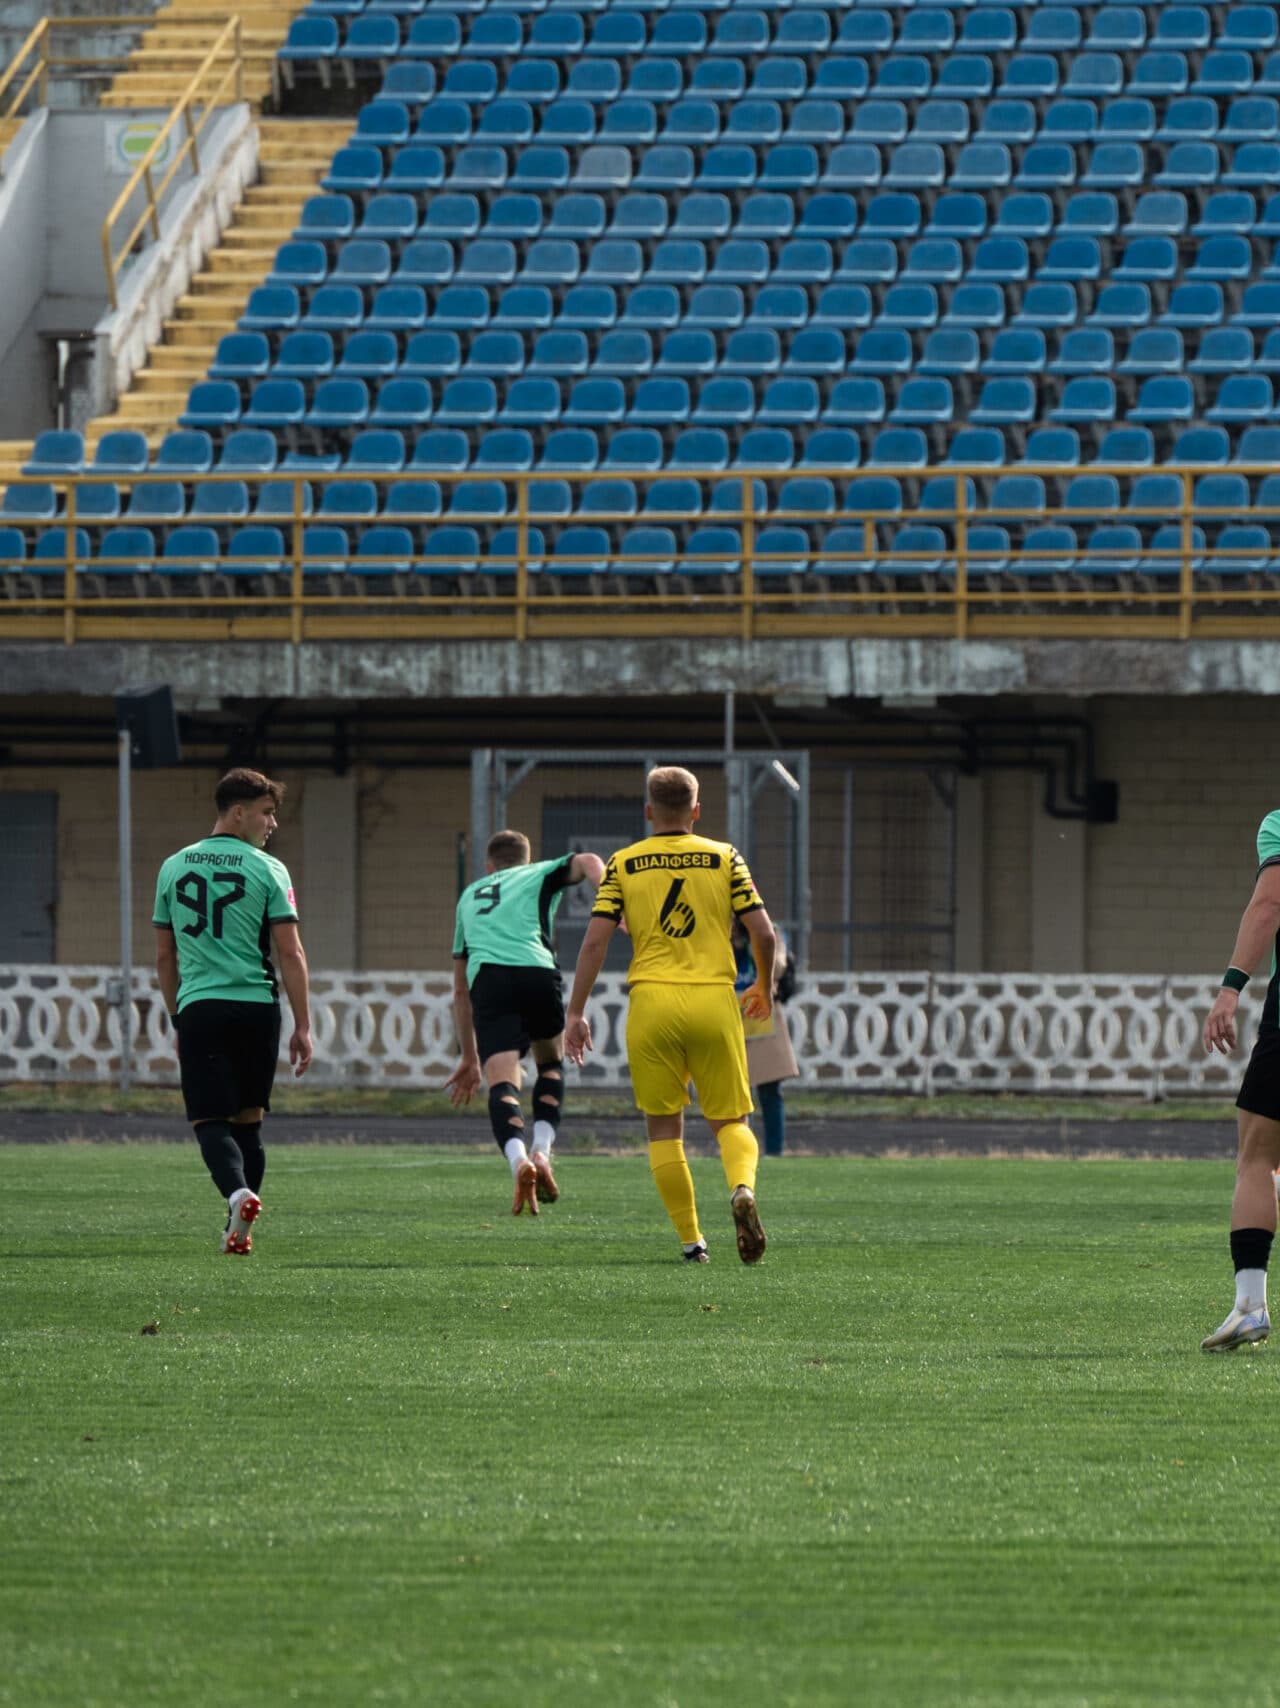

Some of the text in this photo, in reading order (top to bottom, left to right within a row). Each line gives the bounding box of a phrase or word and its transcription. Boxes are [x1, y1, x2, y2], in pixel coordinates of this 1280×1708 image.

[634, 854, 712, 871] ШАЛФЄЄВ
[176, 870, 246, 939] 97
[474, 882, 501, 915] 9
[659, 878, 697, 939] 6
